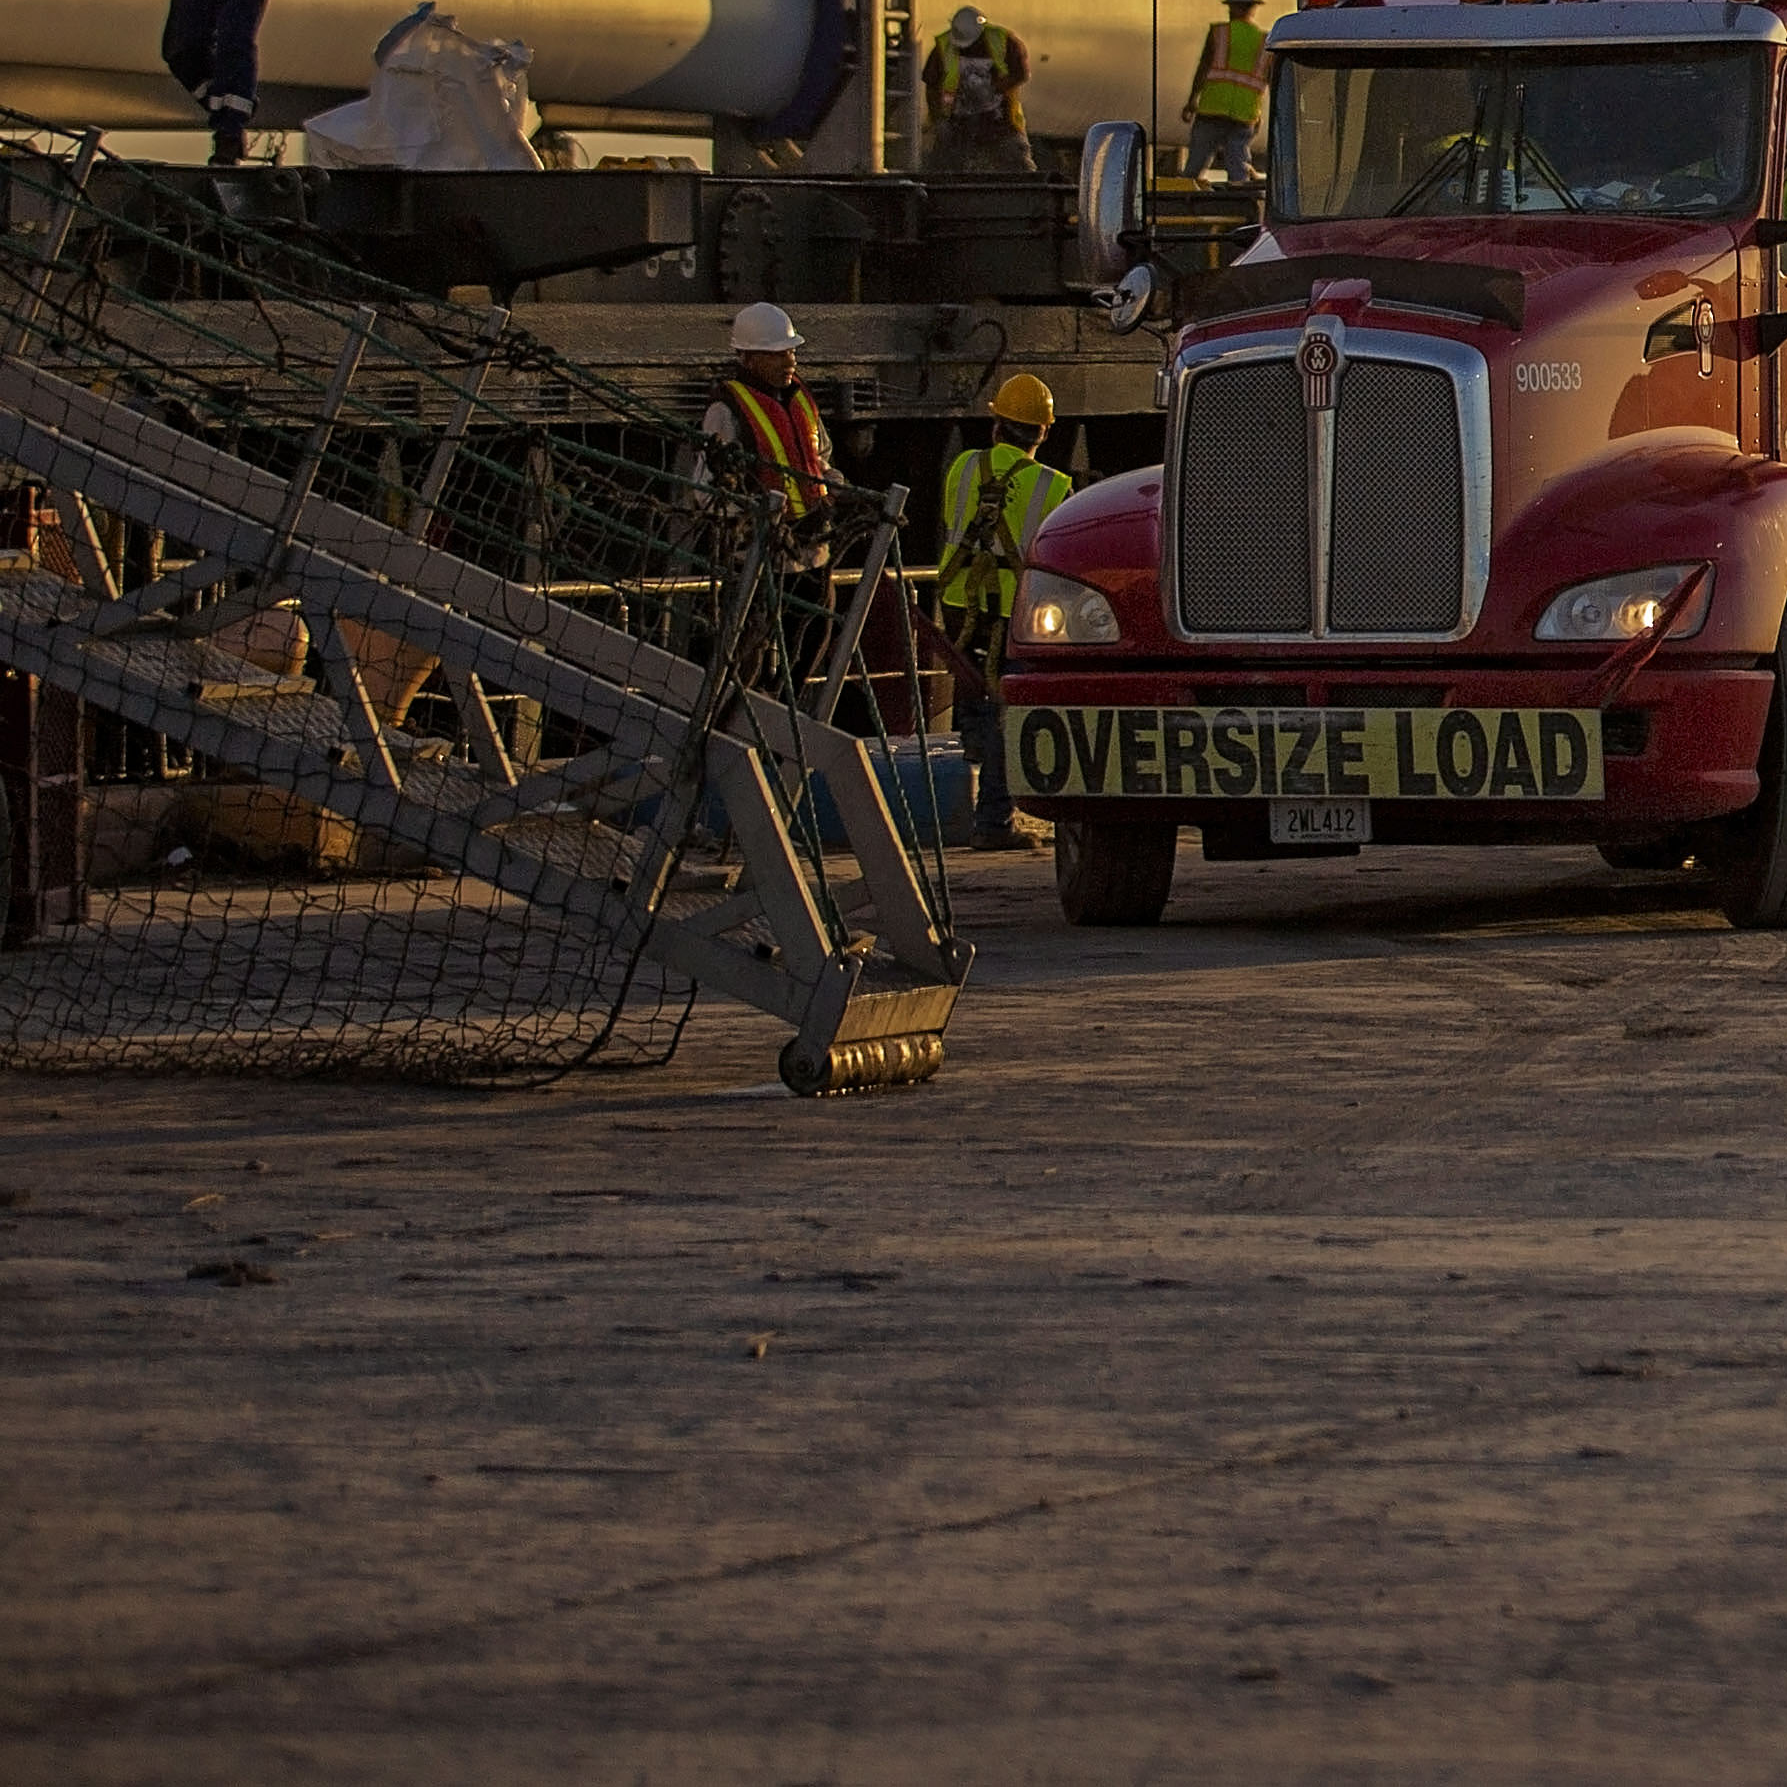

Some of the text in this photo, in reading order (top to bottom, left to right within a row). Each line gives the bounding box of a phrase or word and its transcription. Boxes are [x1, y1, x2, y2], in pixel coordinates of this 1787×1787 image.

[1311, 358, 1326, 369] W
[1313, 347, 1323, 358] K
[1516, 361, 1583, 392] 900533
[1019, 708, 1589, 797] OVERSIZE LOAD
[1288, 808, 1355, 832] 2WL412
